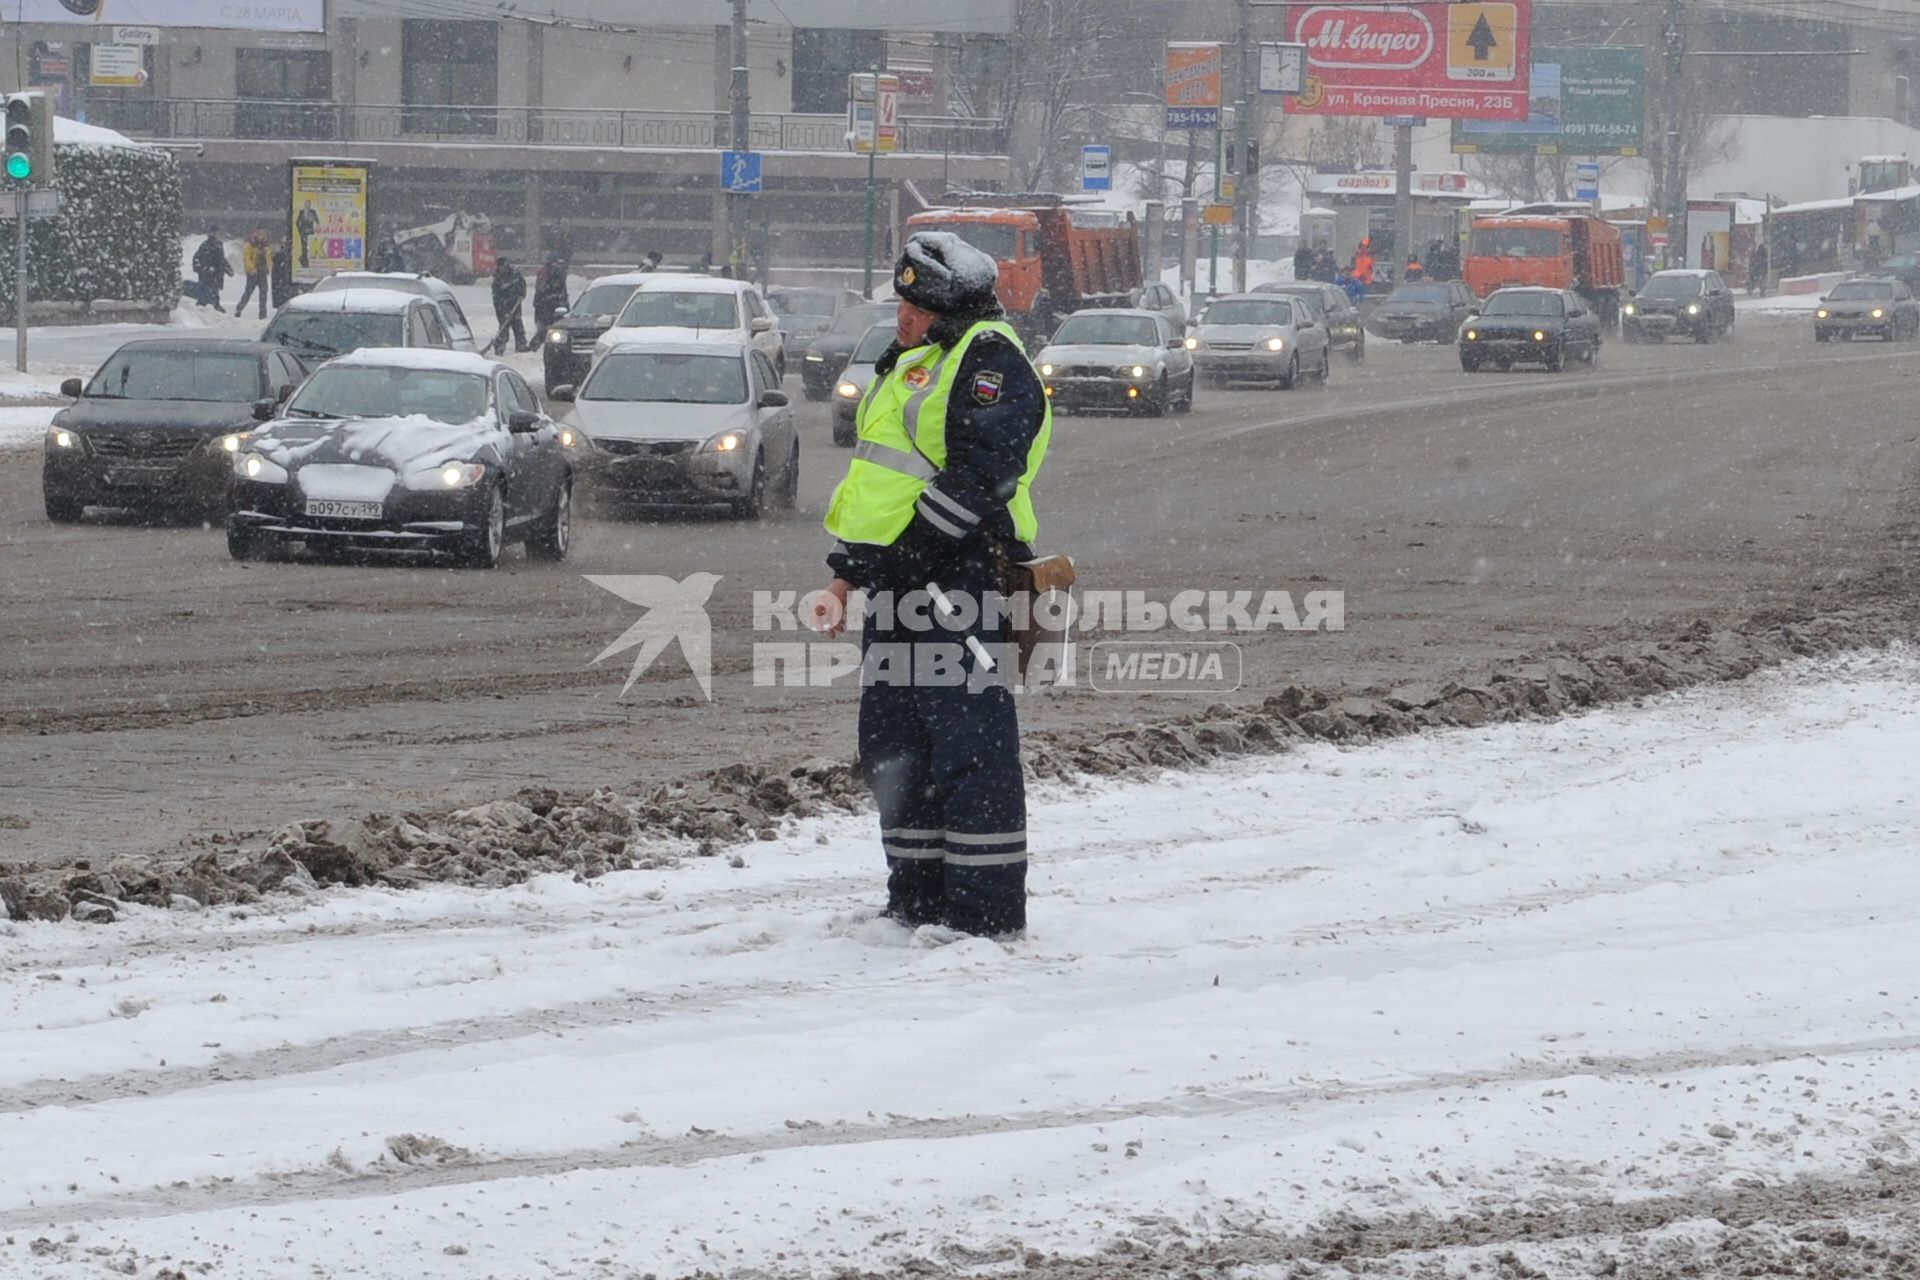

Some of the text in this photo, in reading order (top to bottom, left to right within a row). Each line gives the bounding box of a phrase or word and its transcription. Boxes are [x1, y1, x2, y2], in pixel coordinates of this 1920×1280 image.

[220, 6, 300, 21] С 28 МАРТА
[118, 27, 153, 41] Gallery
[1466, 68, 1486, 78] 200
[1327, 94, 1513, 110] ул. Красная Пресня, 23Б
[1561, 123, 1586, 135] (499)
[310, 238, 362, 260] КВН
